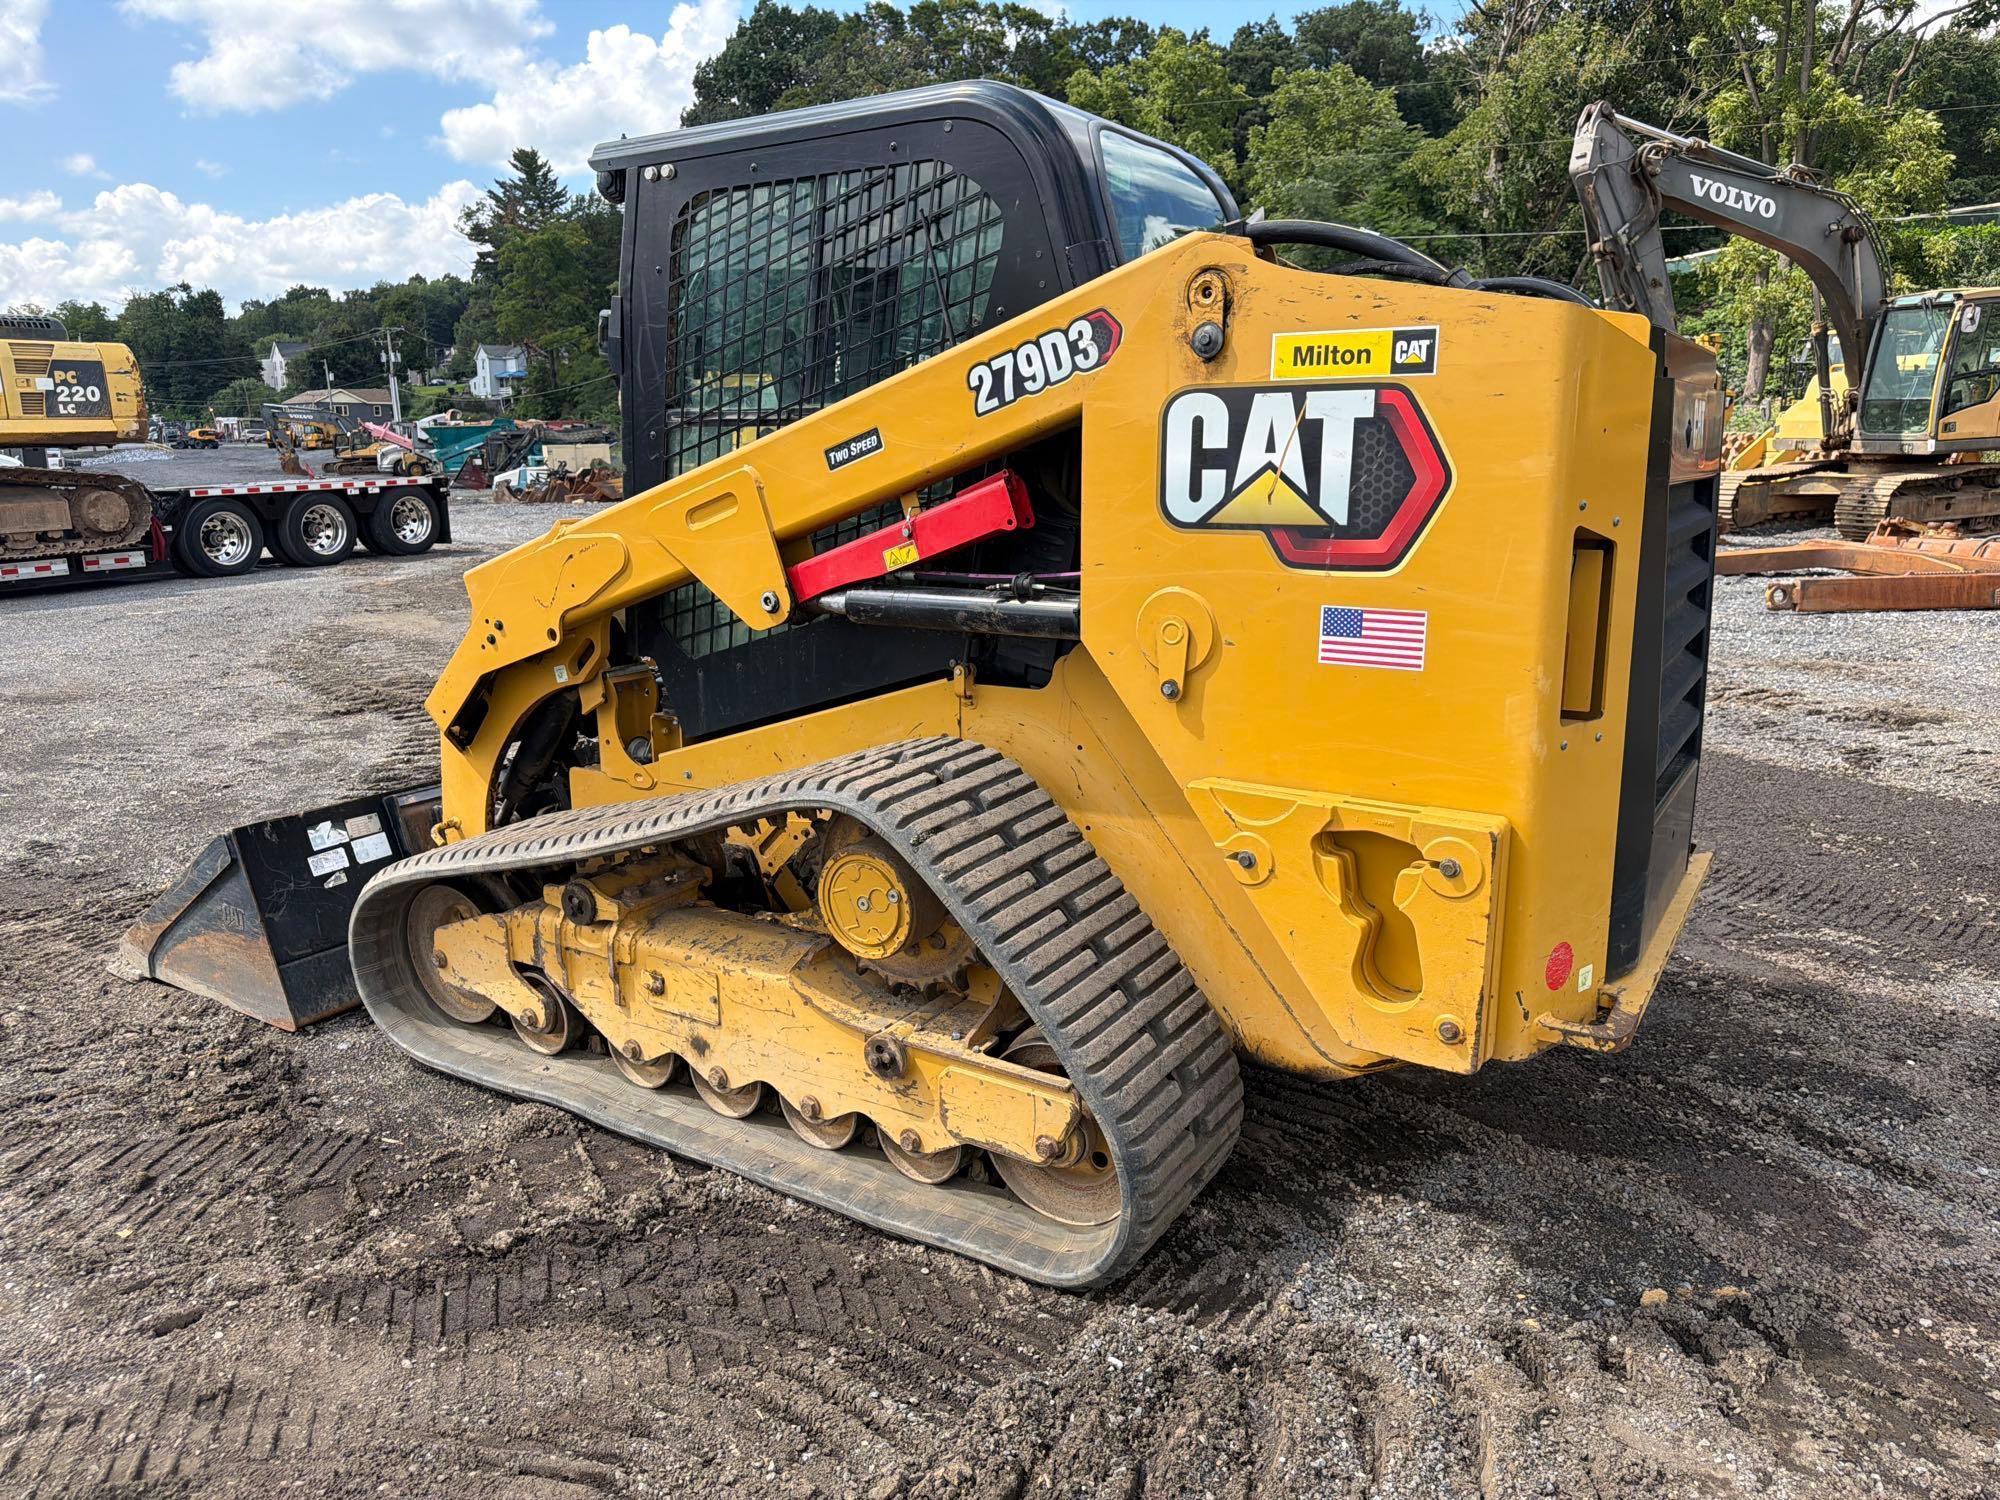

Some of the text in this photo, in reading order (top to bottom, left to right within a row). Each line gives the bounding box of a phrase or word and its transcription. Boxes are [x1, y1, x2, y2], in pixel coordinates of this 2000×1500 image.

[1689, 174, 1776, 218] VOLVO
[1292, 345, 1372, 367] Milton
[1395, 340, 1431, 364] CAT
[53, 370, 77, 384] PC
[969, 319, 1099, 413] 279D3
[56, 385, 100, 402] 220
[58, 403, 76, 414] LC
[1165, 389, 1375, 526] CAT
